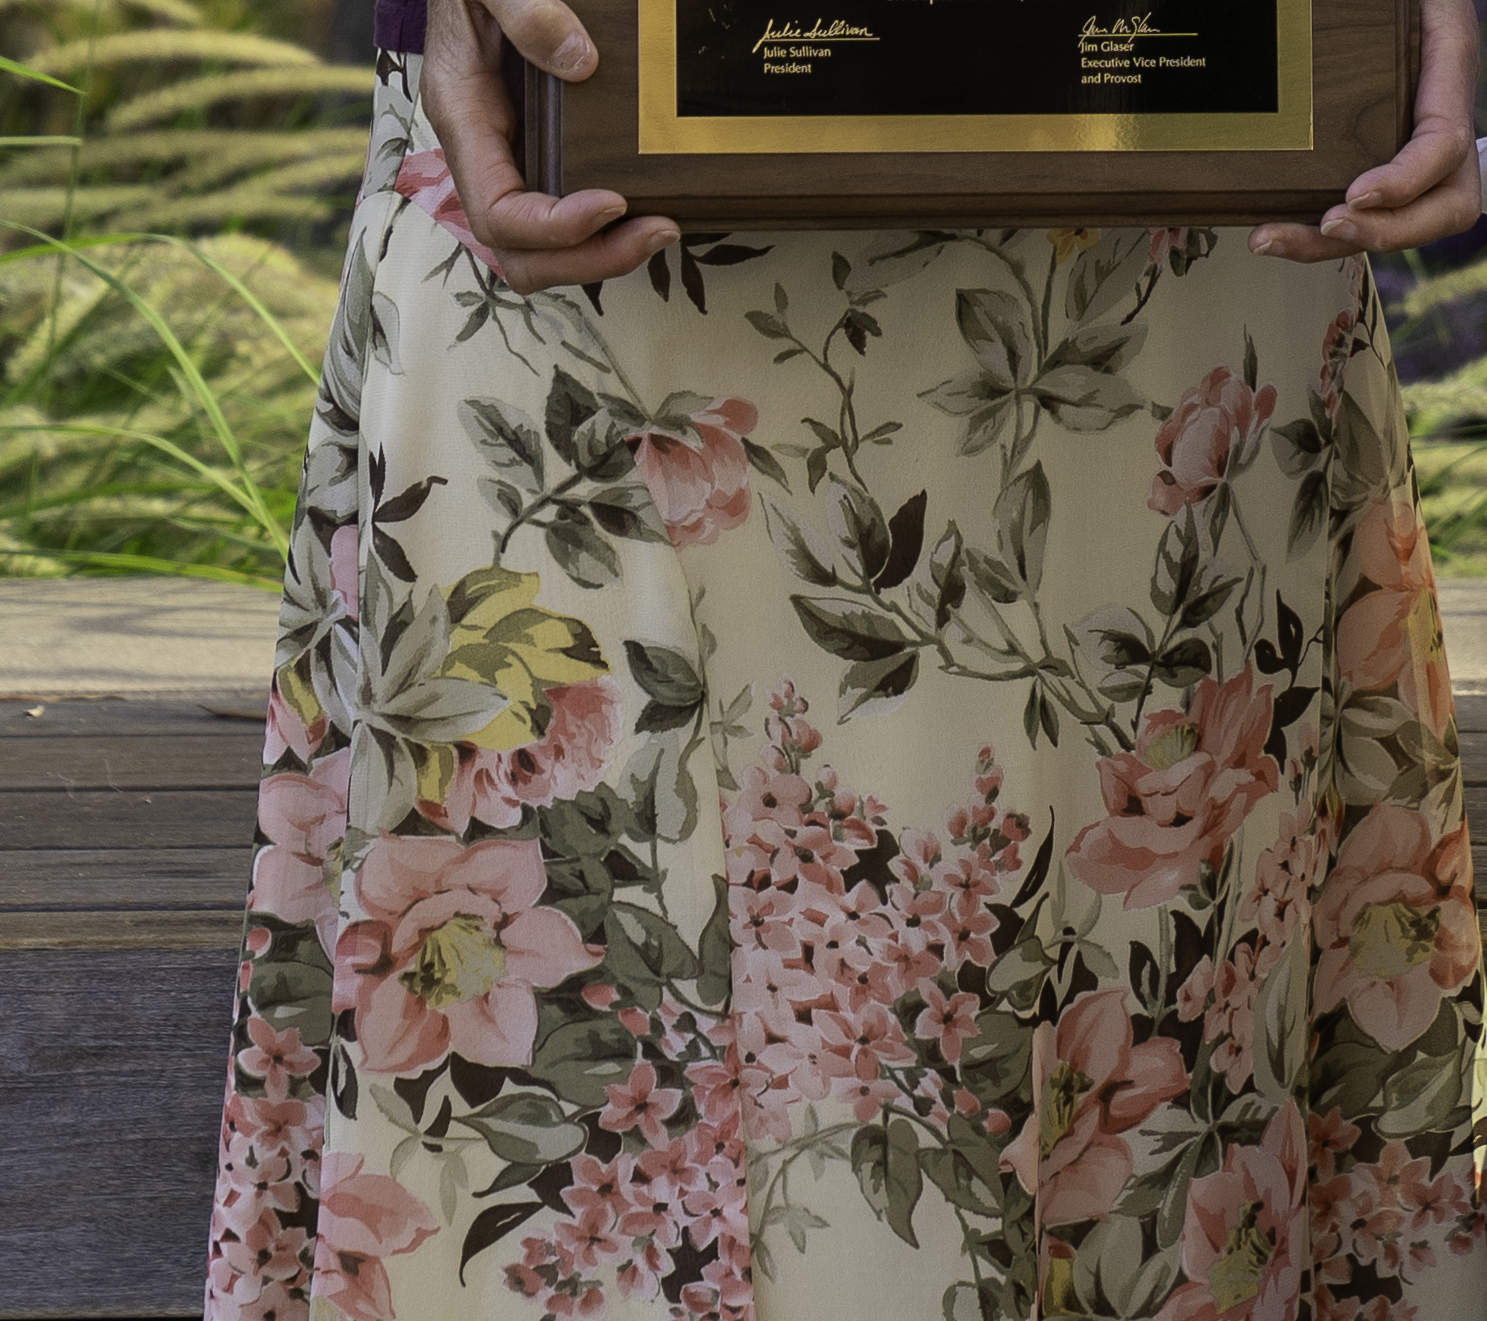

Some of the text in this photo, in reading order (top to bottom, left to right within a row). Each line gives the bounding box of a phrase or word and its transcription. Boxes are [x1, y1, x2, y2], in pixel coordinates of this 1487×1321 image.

[763, 45, 832, 59] Julie Sullivan
[1080, 41, 1135, 54] Jim Glaser
[763, 62, 812, 74] President
[1081, 55, 1206, 68] Executive Vice President
[1081, 72, 1142, 84] and Provost
